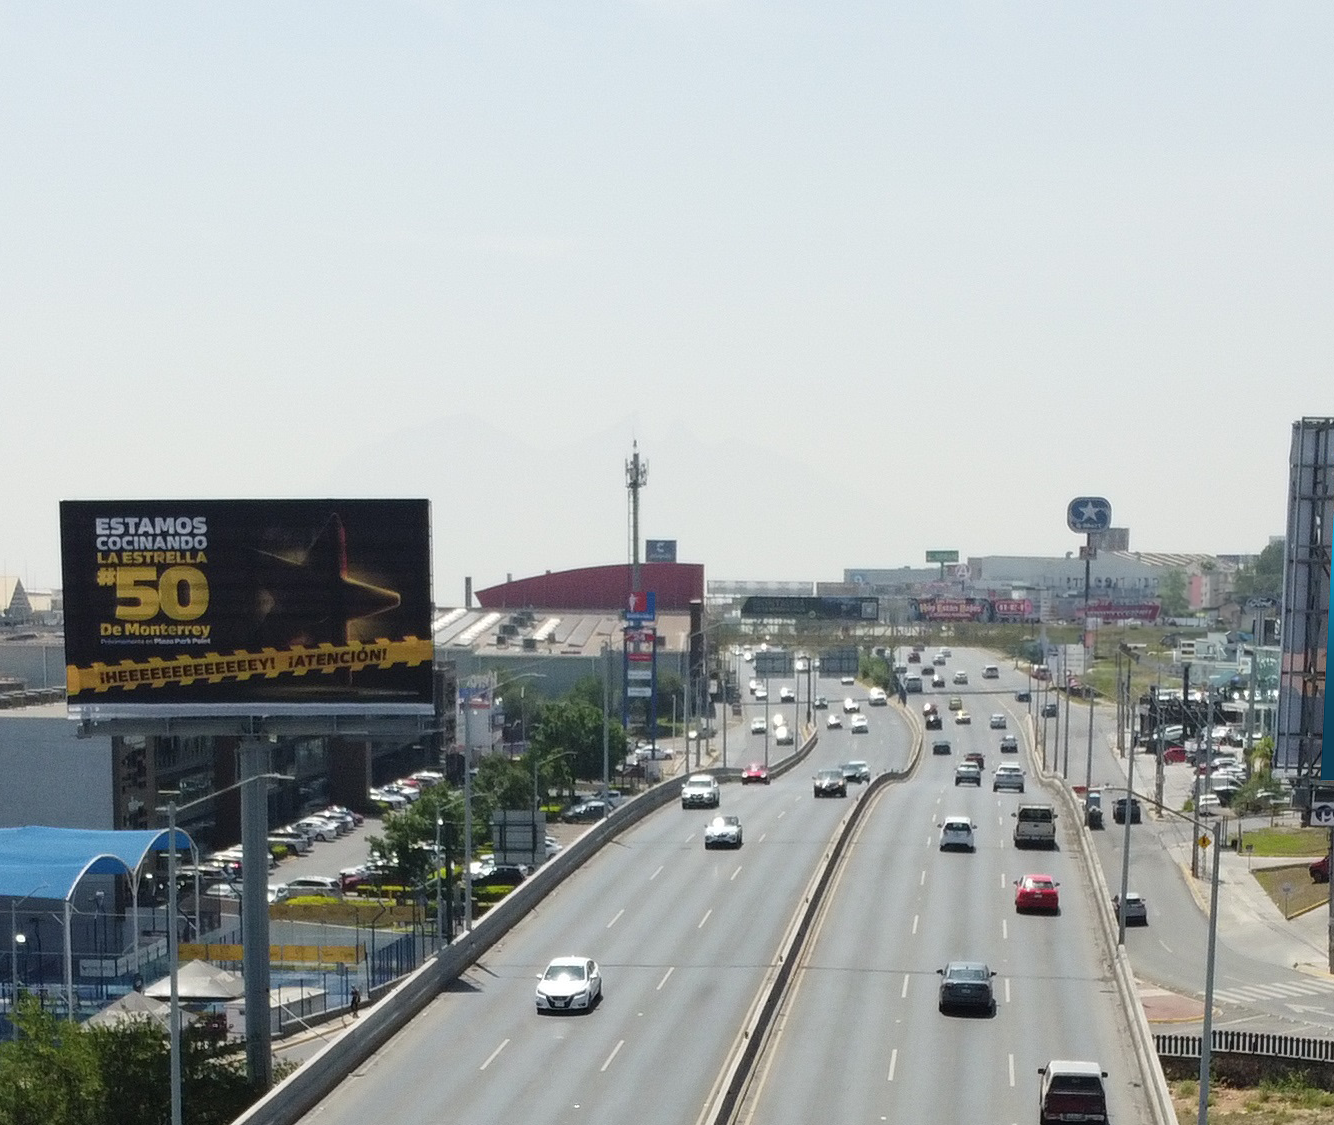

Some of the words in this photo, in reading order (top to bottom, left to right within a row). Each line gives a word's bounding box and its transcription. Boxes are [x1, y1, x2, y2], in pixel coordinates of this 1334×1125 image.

[95, 516, 208, 535] ESTAMOS
[96, 535, 208, 550] COCINANDO
[97, 552, 118, 564] LA
[122, 551, 208, 564] ESTRELLA
[96, 565, 210, 621] #50
[100, 623, 122, 636] De
[125, 623, 211, 638] Monterrey
[288, 647, 387, 669] ¡ATENCIÓN!
